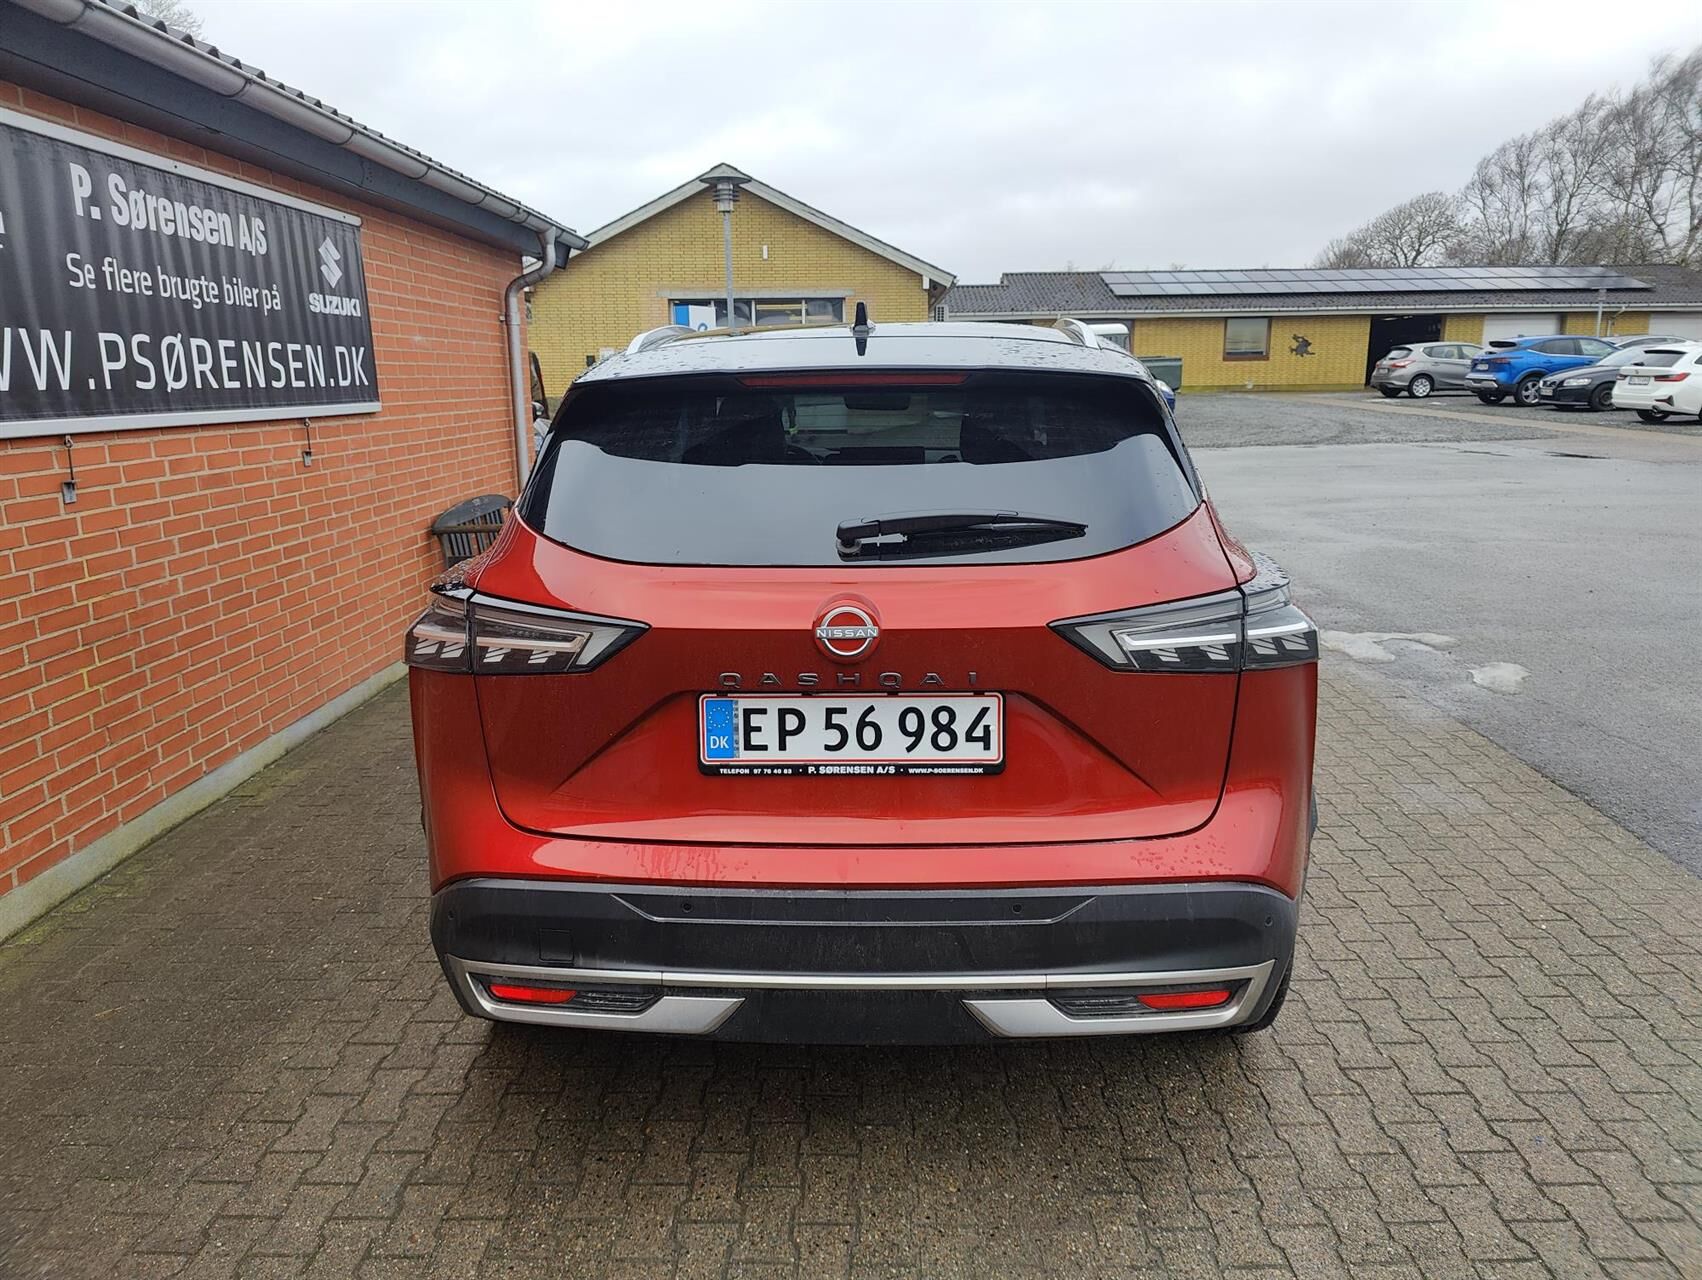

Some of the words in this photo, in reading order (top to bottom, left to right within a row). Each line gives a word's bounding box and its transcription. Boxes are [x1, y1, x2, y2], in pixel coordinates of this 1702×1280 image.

[69, 162, 102, 220] P.
[107, 172, 234, 248] Sørensen
[239, 214, 268, 256] A/S
[66, 252, 96, 290] Se
[101, 256, 153, 296] flere
[157, 265, 219, 310] brugte
[222, 275, 261, 309] biler
[261, 283, 282, 316] på
[308, 292, 362, 318] SUZUKI
[0, 326, 369, 393] W.PSØRENSEN.DK
[816, 627, 878, 638] NISSAN
[719, 672, 977, 689] QASHQAI
[742, 707, 807, 752] EP
[823, 704, 883, 752] 56
[898, 705, 992, 753] 984
[710, 735, 730, 750] DK
[807, 765, 817, 775] P.
[818, 765, 874, 775] SØRENSEN
[876, 765, 896, 775] A/S
